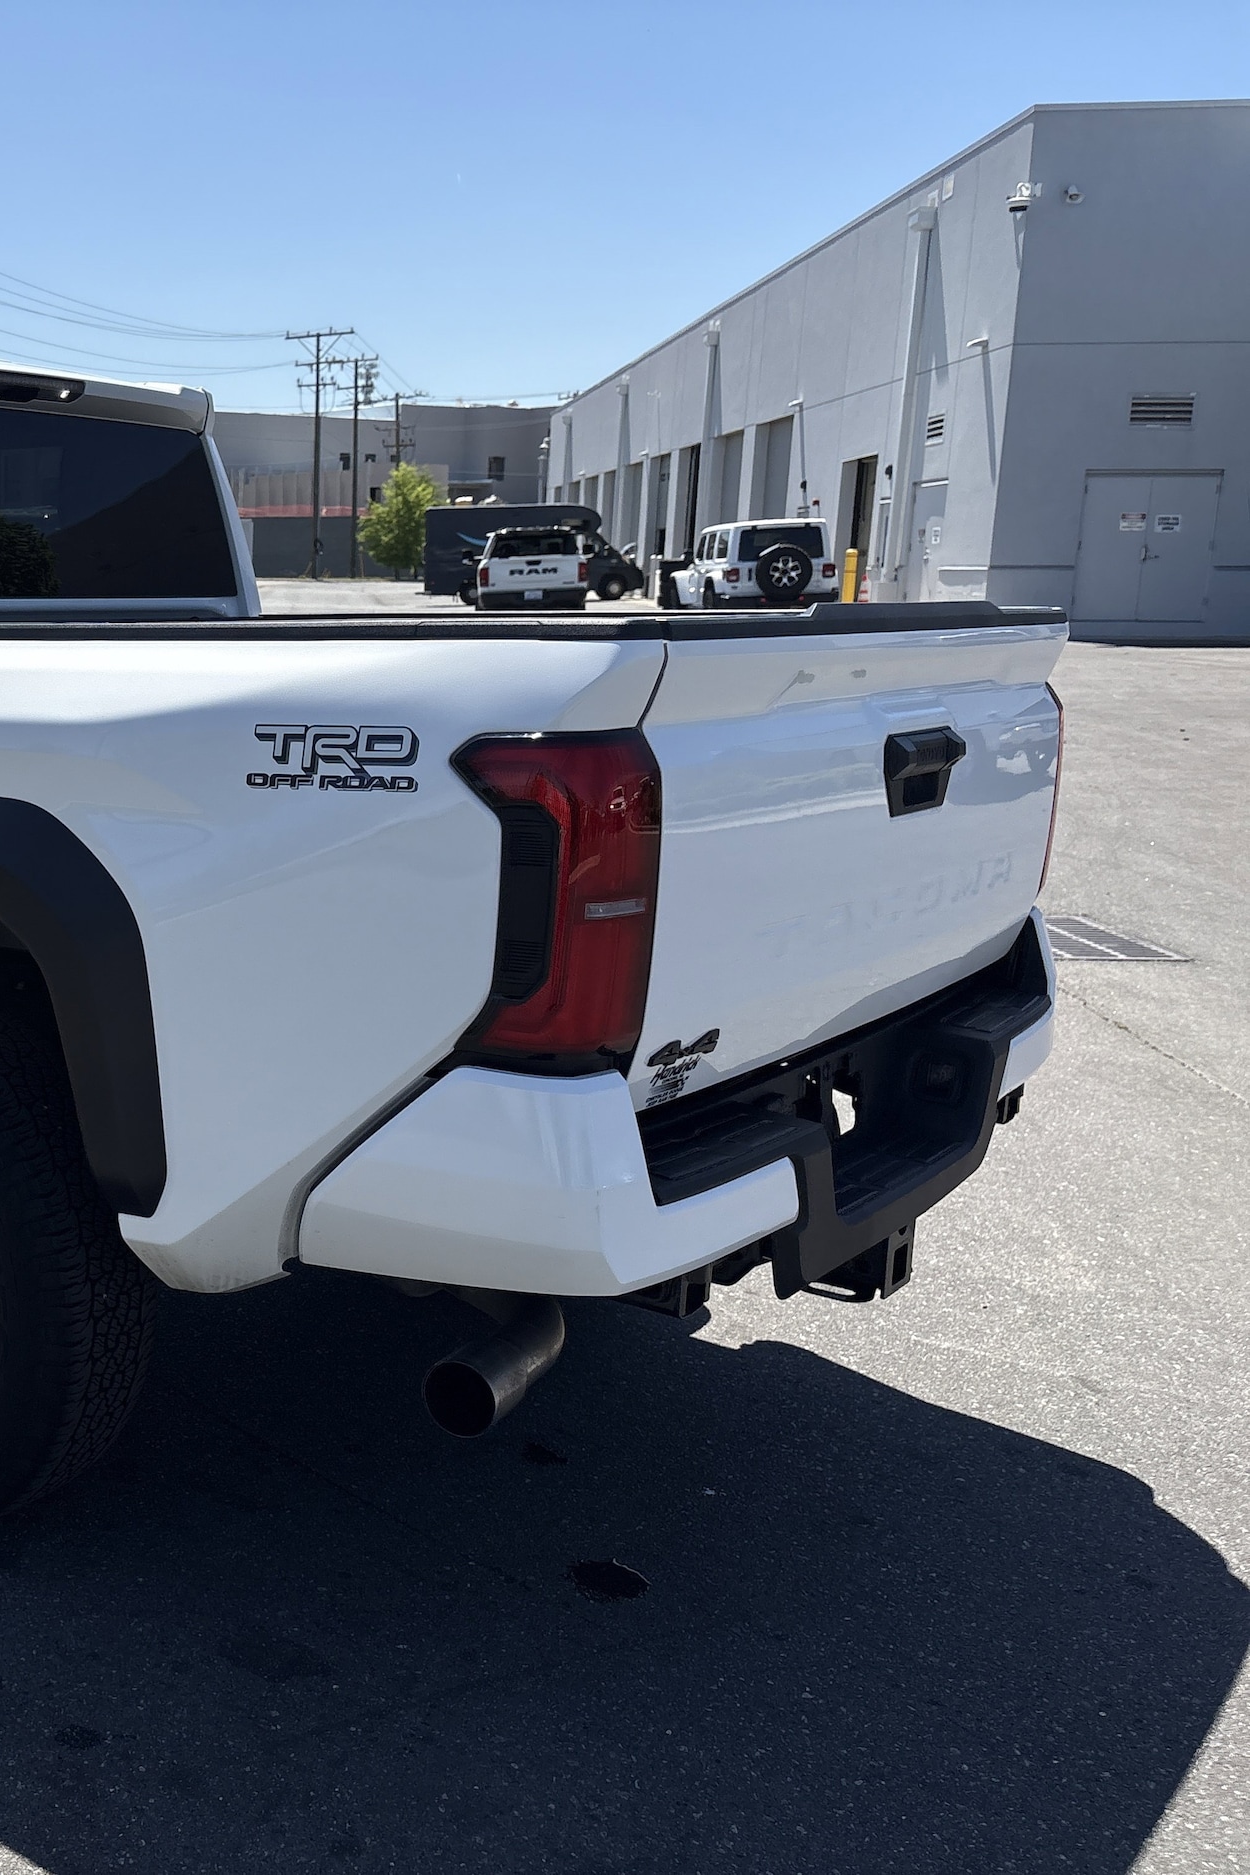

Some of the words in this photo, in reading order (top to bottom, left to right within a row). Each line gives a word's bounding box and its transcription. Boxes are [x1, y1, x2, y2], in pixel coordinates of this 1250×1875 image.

[509, 567, 558, 576] RAM
[254, 723, 420, 776] TRD
[246, 772, 314, 790] OFF
[318, 774, 419, 793] ROAD
[650, 1054, 702, 1088] Hendrick
